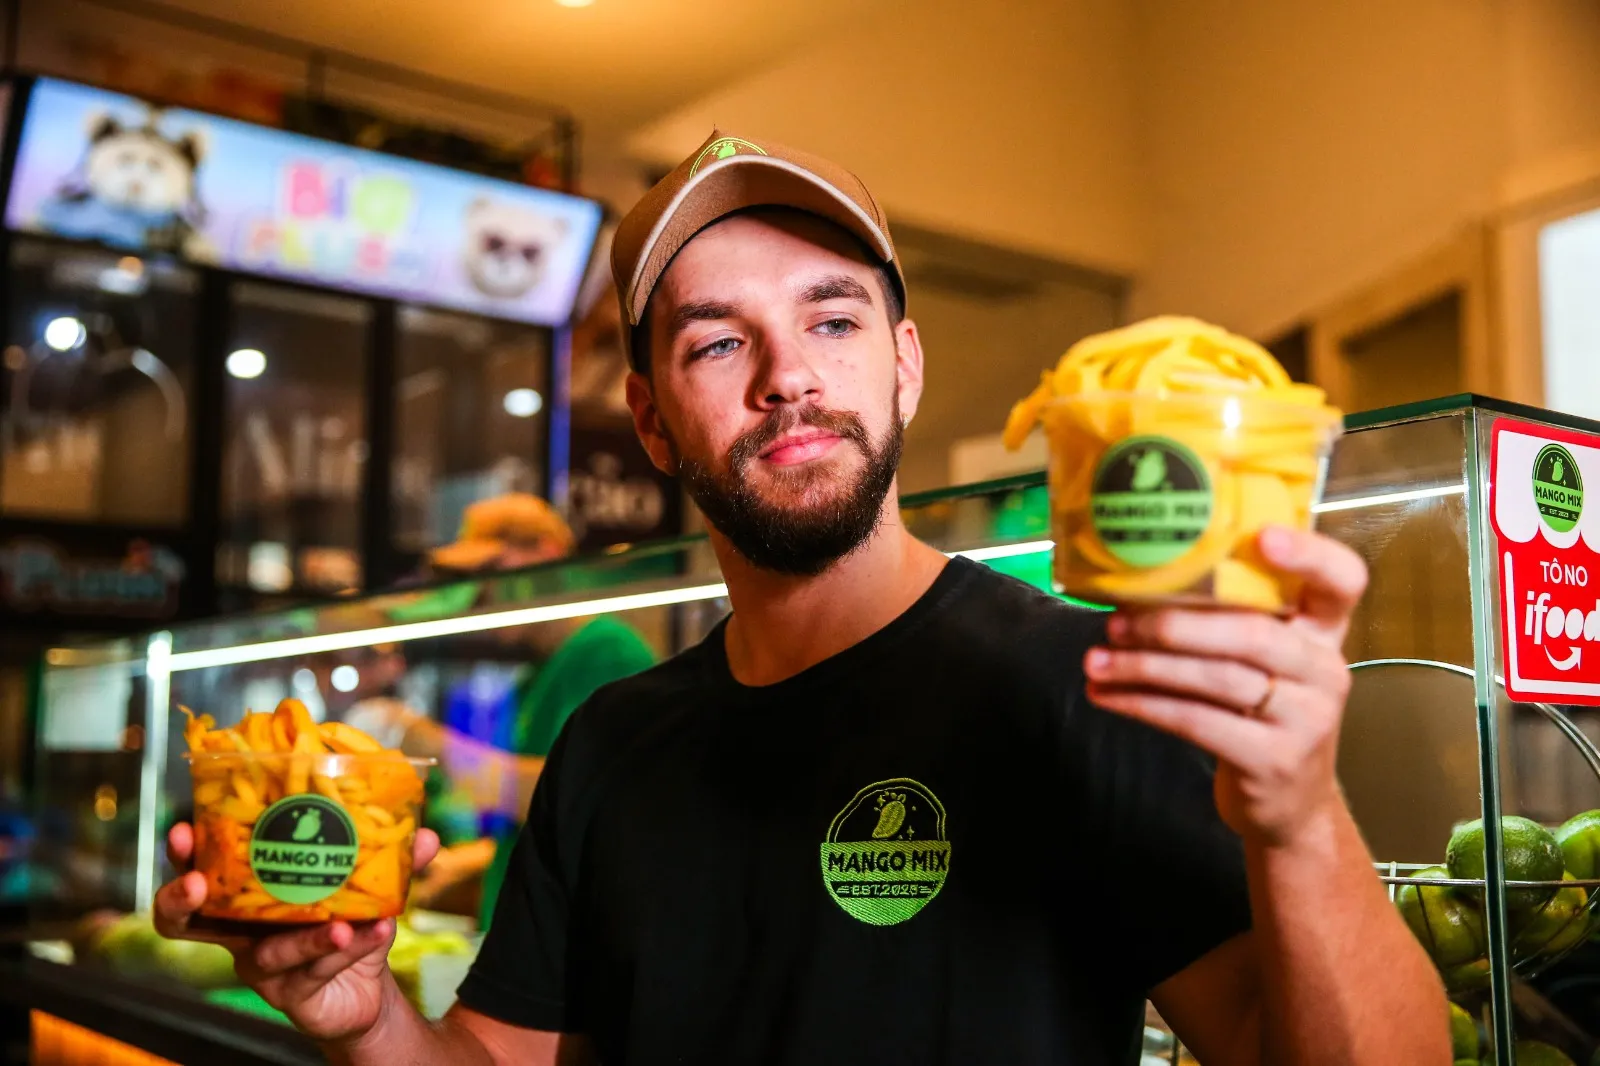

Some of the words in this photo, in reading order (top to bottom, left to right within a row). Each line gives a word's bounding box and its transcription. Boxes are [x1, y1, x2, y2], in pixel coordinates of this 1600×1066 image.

[1535, 485, 1565, 503] MANGO
[1567, 493, 1581, 507] MIX
[1539, 557, 1563, 584] TÔ
[1564, 563, 1588, 587] NO
[1524, 590, 1600, 645] ifood
[253, 847, 319, 867] MANGO
[325, 853, 355, 868] MIX
[828, 850, 906, 873] MANGO
[911, 849, 948, 872] MIX
